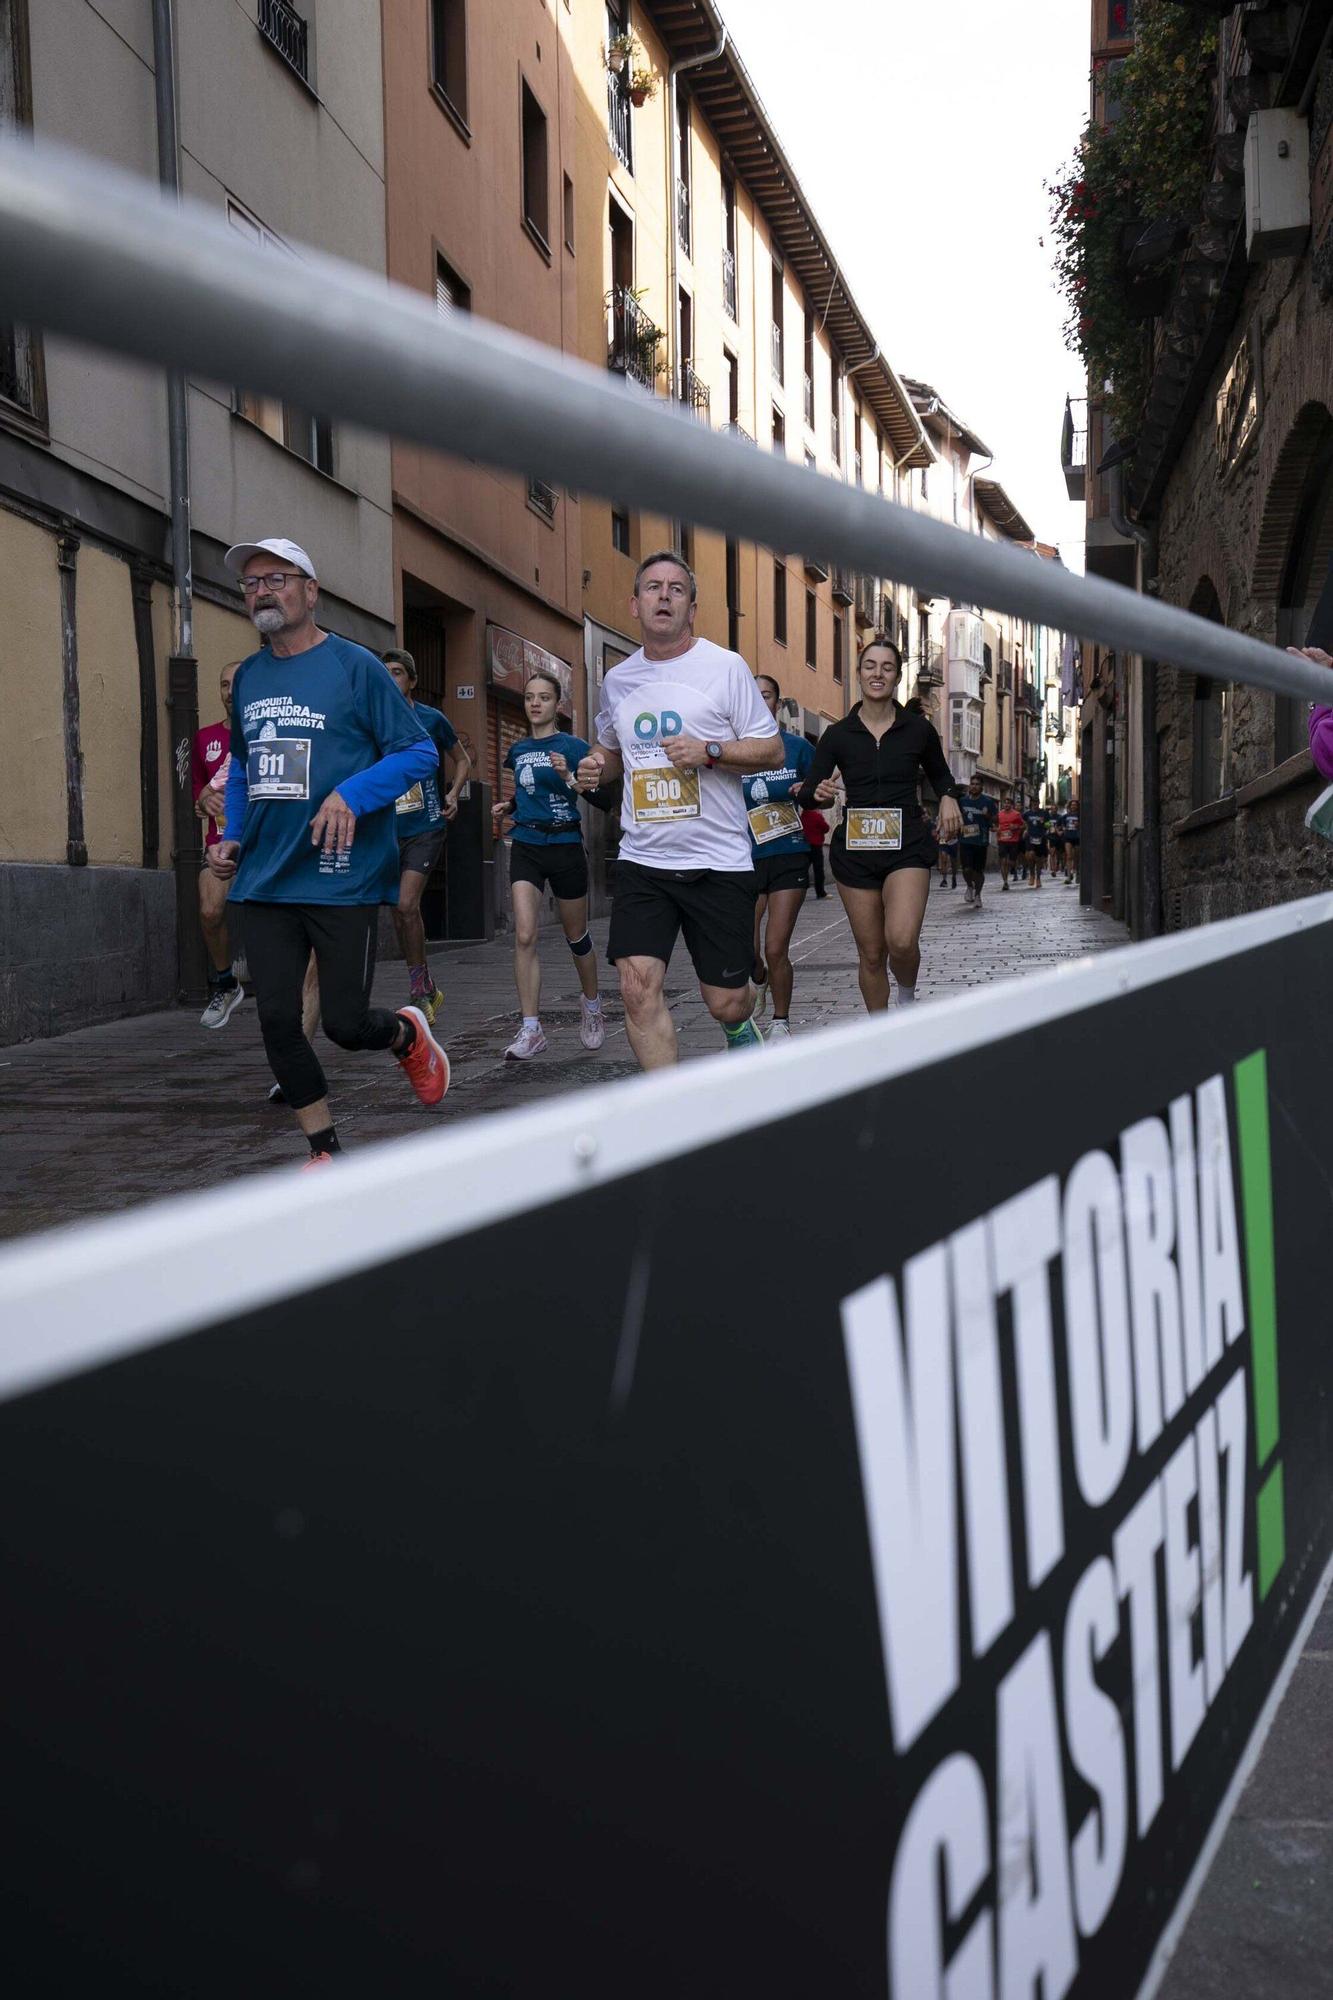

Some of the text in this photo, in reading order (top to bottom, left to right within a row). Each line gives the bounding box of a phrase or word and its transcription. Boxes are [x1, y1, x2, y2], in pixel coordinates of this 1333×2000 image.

[458, 688, 474, 697] 46
[250, 696, 293, 711] CONQUISTA
[277, 717, 325, 730] KONKISTA
[258, 753, 285, 776] 911
[765, 773, 797, 782] KONKISTA
[646, 779, 681, 802] 500
[861, 818, 886, 834] 370
[841, 1074, 1245, 1756] VITORIA
